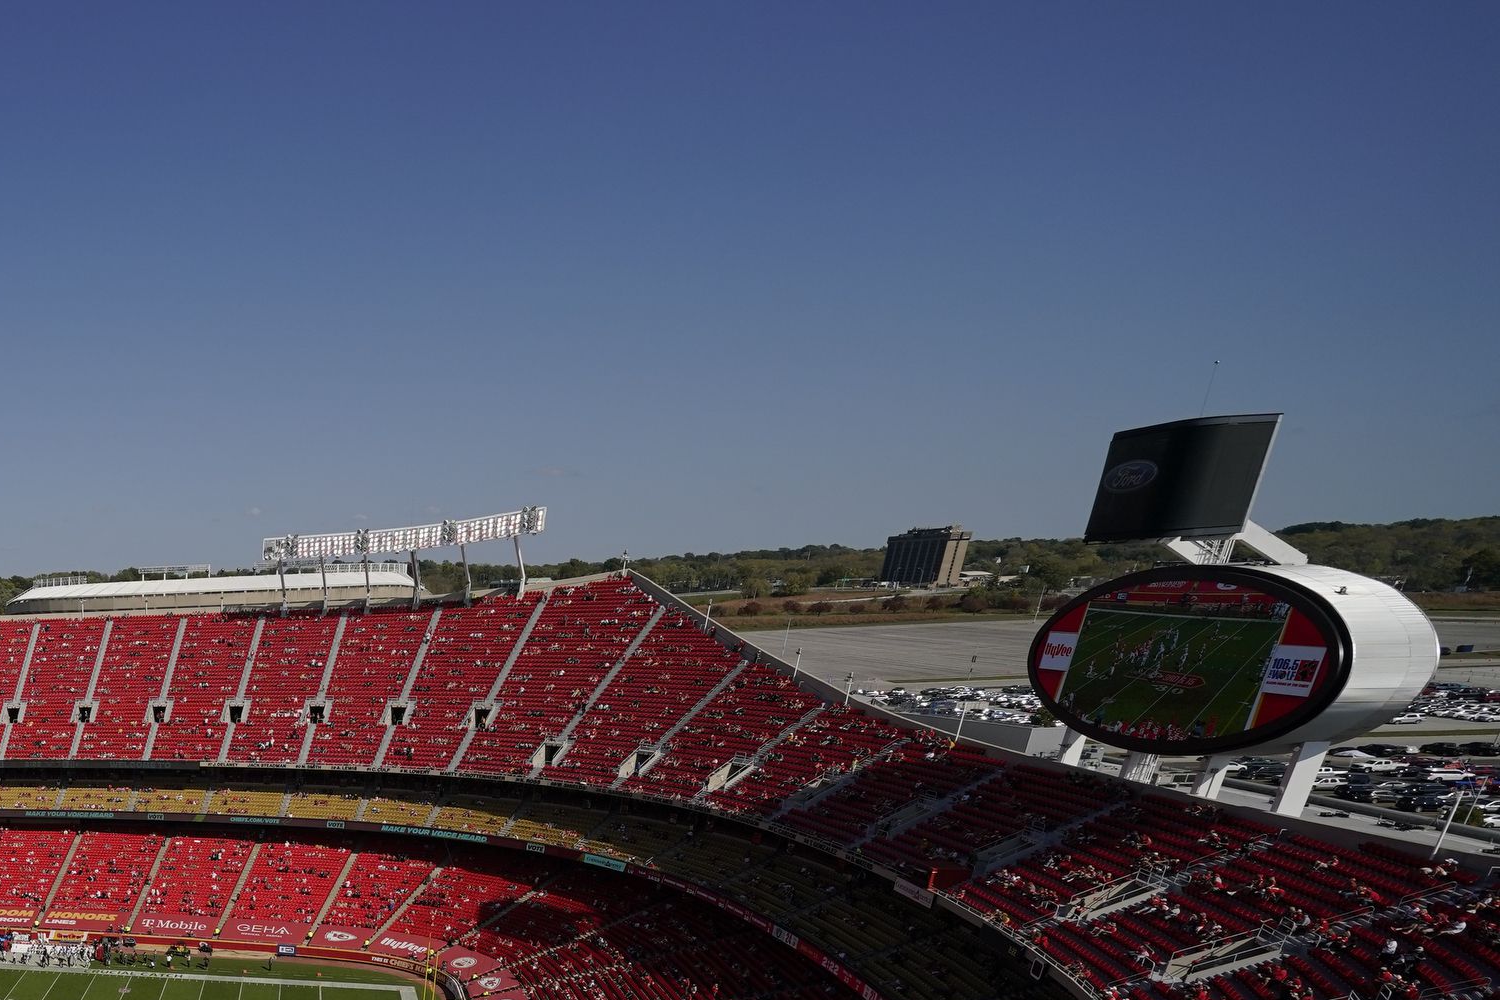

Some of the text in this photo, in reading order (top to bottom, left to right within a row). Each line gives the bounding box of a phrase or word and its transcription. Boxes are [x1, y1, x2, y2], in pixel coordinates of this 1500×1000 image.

[1113, 465, 1146, 489] Ford
[1271, 658, 1300, 671] 106.5
[381, 825, 487, 842] MAKE YOUR VOICE HEARD
[48, 910, 118, 922] HONORS
[156, 919, 207, 931] Mobile
[236, 923, 291, 935] GEHA
[389, 958, 414, 971] CHIEFS
[149, 971, 184, 979] CATCH
